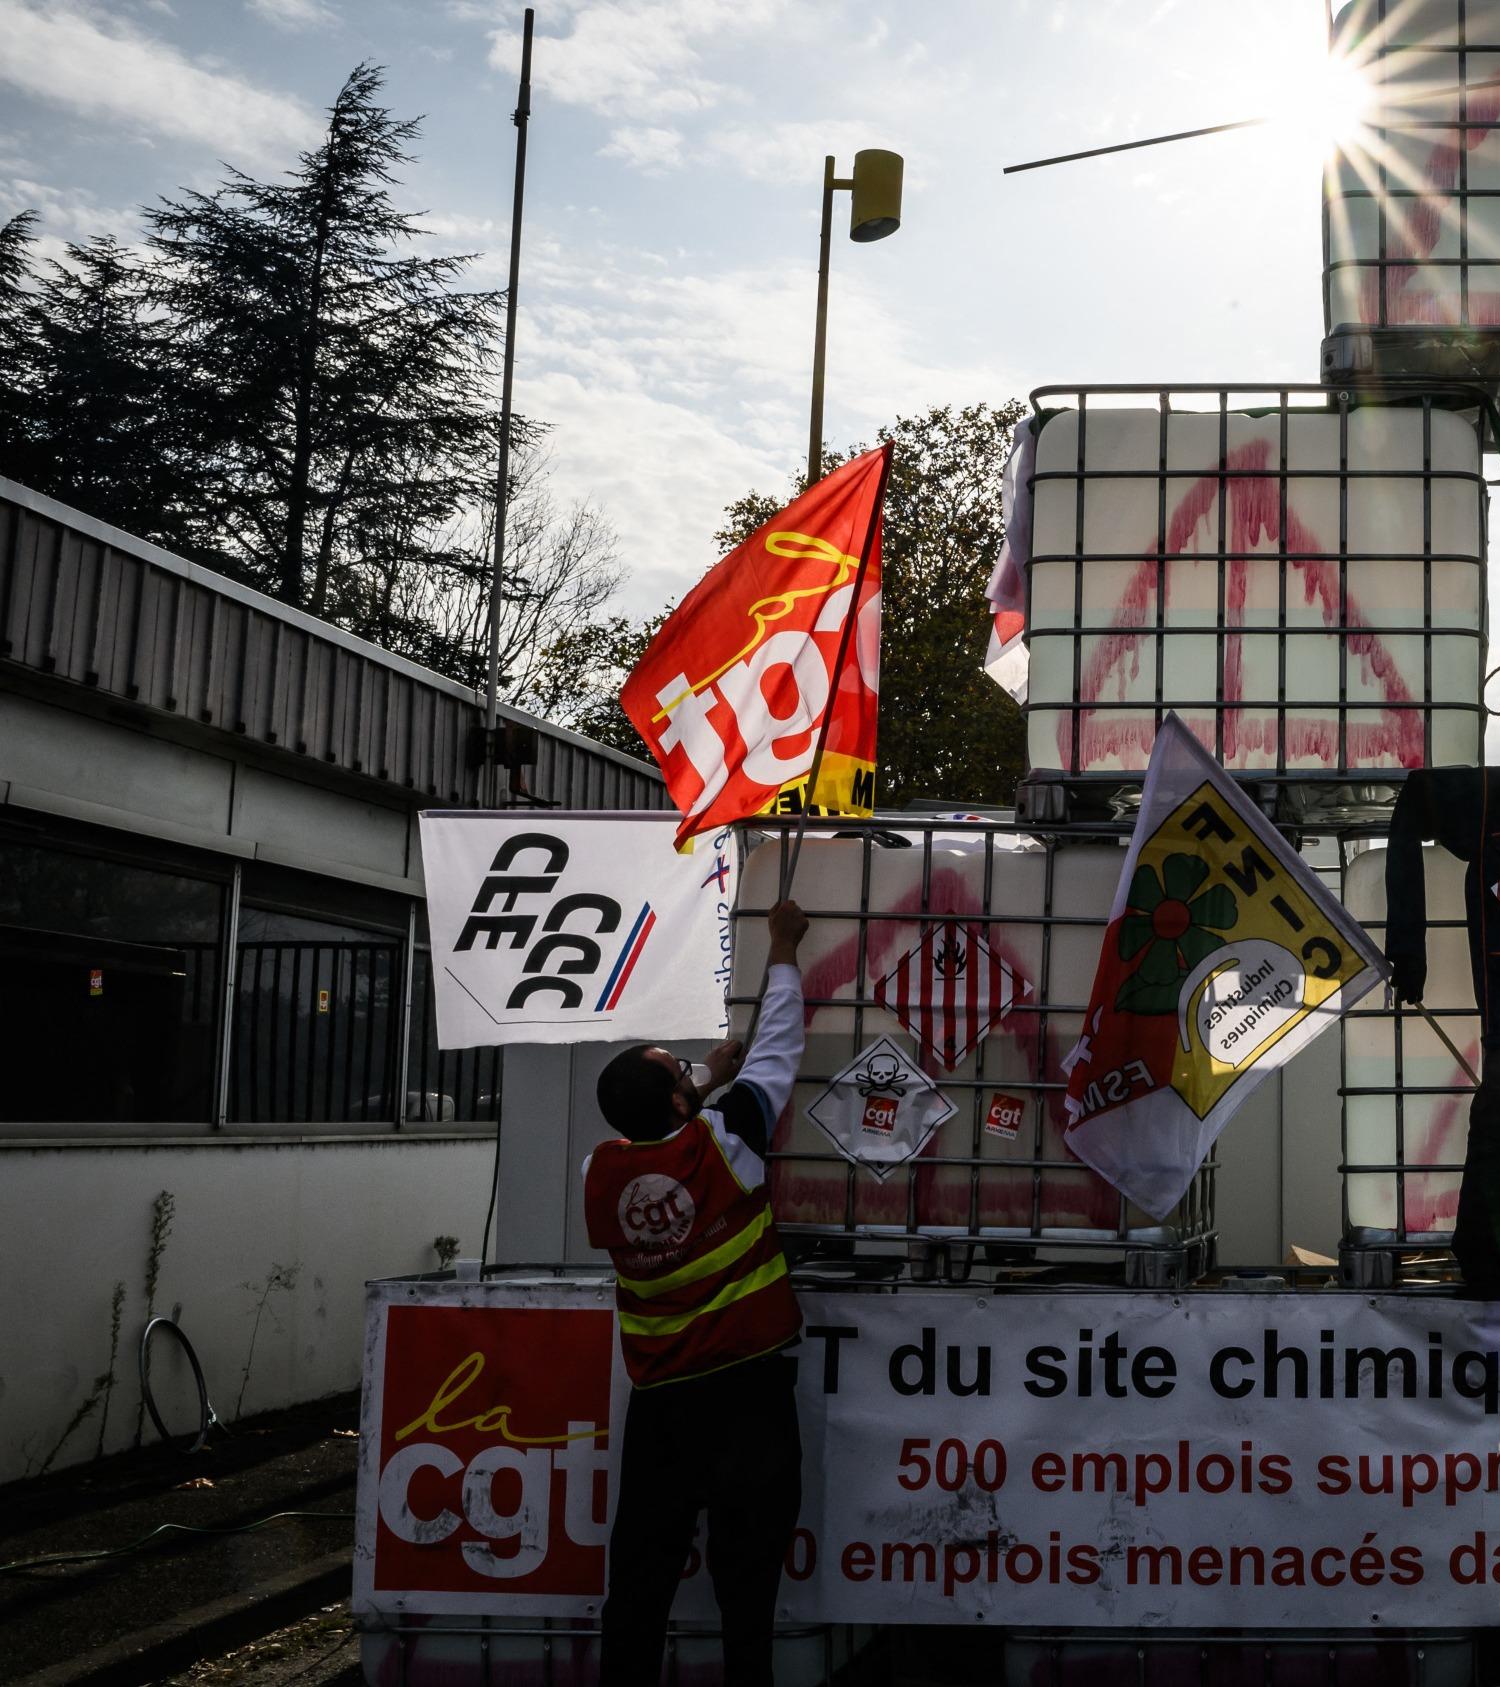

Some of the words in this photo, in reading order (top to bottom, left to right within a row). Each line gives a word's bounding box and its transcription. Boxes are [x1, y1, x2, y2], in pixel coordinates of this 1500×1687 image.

[865, 1106, 895, 1127] cgt
[991, 1106, 1021, 1126] cgt
[625, 1191, 686, 1235] cgt
[888, 1327, 991, 1396] du
[1023, 1329, 1178, 1398] site
[395, 1352, 609, 1443] la
[378, 1420, 609, 1579] cgt
[897, 1438, 1007, 1491] 500
[1031, 1440, 1293, 1506] emplois
[840, 1531, 1100, 1596] emplois
[1126, 1532, 1424, 1586] menacés
